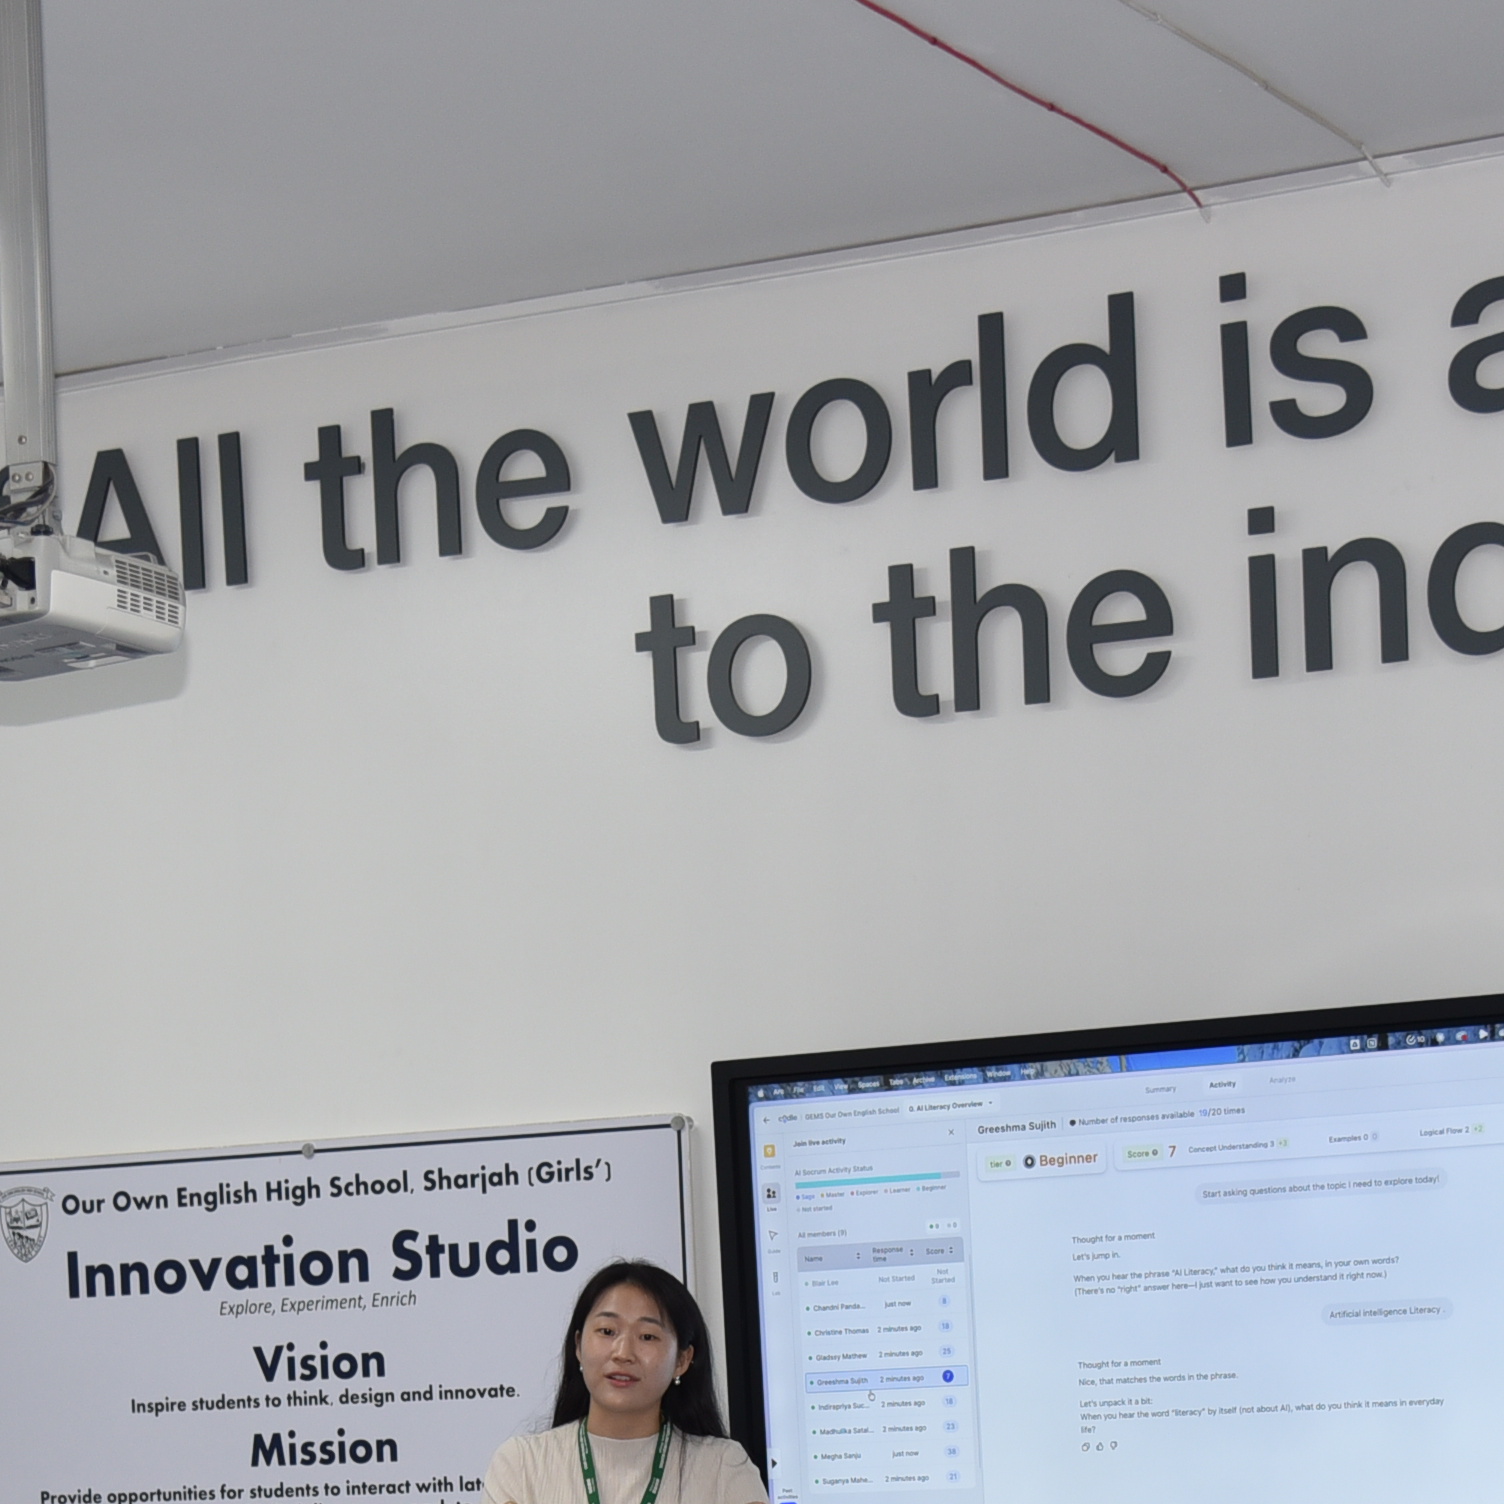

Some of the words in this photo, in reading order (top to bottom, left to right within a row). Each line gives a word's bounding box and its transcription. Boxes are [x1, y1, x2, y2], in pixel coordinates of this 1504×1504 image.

[304, 408, 572, 571] the
[628, 291, 1140, 525] world
[1219, 272, 1374, 440] is
[635, 593, 813, 745] to
[872, 546, 1174, 718] the
[1078, 1117, 1108, 1126] Number
[1110, 1115, 1118, 1124] of
[1120, 1114, 1160, 1123] responses
[1161, 1110, 1195, 1120] available
[1199, 1108, 1222, 1117] 19/20
[1223, 1107, 1245, 1115] times
[977, 1124, 1026, 1135] Greeshma
[1028, 1120, 1056, 1132] Sujith
[1419, 1128, 1445, 1137] Logical
[1188, 1145, 1217, 1153] Concept
[1218, 1142, 1268, 1151] Understanding
[1329, 1135, 1362, 1143] Examples
[1127, 1150, 1149, 1159] Score
[1168, 1145, 1177, 1158] 7
[990, 1160, 1003, 1168] tier
[1039, 1153, 1098, 1168] Beginner
[61, 1194, 105, 1215] Our
[112, 1190, 168, 1212] Own
[177, 1181, 257, 1212] English
[266, 1176, 321, 1207] High
[329, 1170, 414, 1198] School,
[423, 1163, 519, 1194] Sharjah
[1202, 1190, 1221, 1199] Start
[1223, 1188, 1248, 1198] asking
[1249, 1186, 1287, 1196] questions
[1288, 1184, 1311, 1193] about
[1312, 1183, 1325, 1191] the
[1327, 1181, 1347, 1191] topic
[1352, 1179, 1373, 1188] need
[1374, 1179, 1383, 1187] to
[1384, 1177, 1413, 1187] explore
[1414, 1174, 1440, 1184] today!
[1072, 1235, 1103, 1244] Thought
[1105, 1234, 1116, 1242] for
[1124, 1232, 1155, 1241] moment
[67, 1235, 370, 1299] Innovation
[392, 1219, 579, 1281] Studio
[1073, 1275, 1095, 1283] When
[1096, 1275, 1110, 1283] you
[1144, 1271, 1170, 1280] phrase
[1220, 1266, 1238, 1274] what
[1240, 1265, 1250, 1273] do
[1252, 1265, 1266, 1274] you
[1267, 1263, 1287, 1271] think
[1295, 1262, 1323, 1270] means,
[1325, 1260, 1333, 1268] in
[1334, 1260, 1352, 1269] your
[1371, 1256, 1399, 1265] words?
[219, 1299, 276, 1319] Explore,
[280, 1294, 366, 1315] Experiment,
[371, 1290, 417, 1308] Enrich
[1329, 1309, 1361, 1319] Artificial
[1363, 1308, 1407, 1318] intelligence
[1409, 1306, 1441, 1315] Literacy
[252, 1340, 385, 1382] Vision
[1078, 1360, 1109, 1370] Thought
[1111, 1360, 1122, 1368] for
[1130, 1358, 1161, 1367] moment
[1078, 1378, 1097, 1387] Nice,
[1099, 1377, 1114, 1385] that
[1115, 1376, 1148, 1384] matches
[1149, 1375, 1161, 1383] the
[1163, 1374, 1186, 1382] words
[1187, 1373, 1195, 1381] in
[1196, 1373, 1209, 1381] the
[1210, 1372, 1238, 1381] phrase.
[131, 1396, 186, 1417] Inspire
[192, 1393, 260, 1411] students
[265, 1394, 282, 1408] to
[286, 1389, 333, 1407] think,
[339, 1387, 395, 1408] design
[400, 1384, 433, 1402] and
[438, 1384, 520, 1400] innovate.
[251, 1427, 398, 1467] Mission
[220, 1483, 244, 1500] for
[250, 1481, 319, 1499] students
[324, 1483, 341, 1496] to
[346, 1479, 411, 1496] interact
[415, 1476, 454, 1493] with
[459, 1475, 484, 1492] lat
